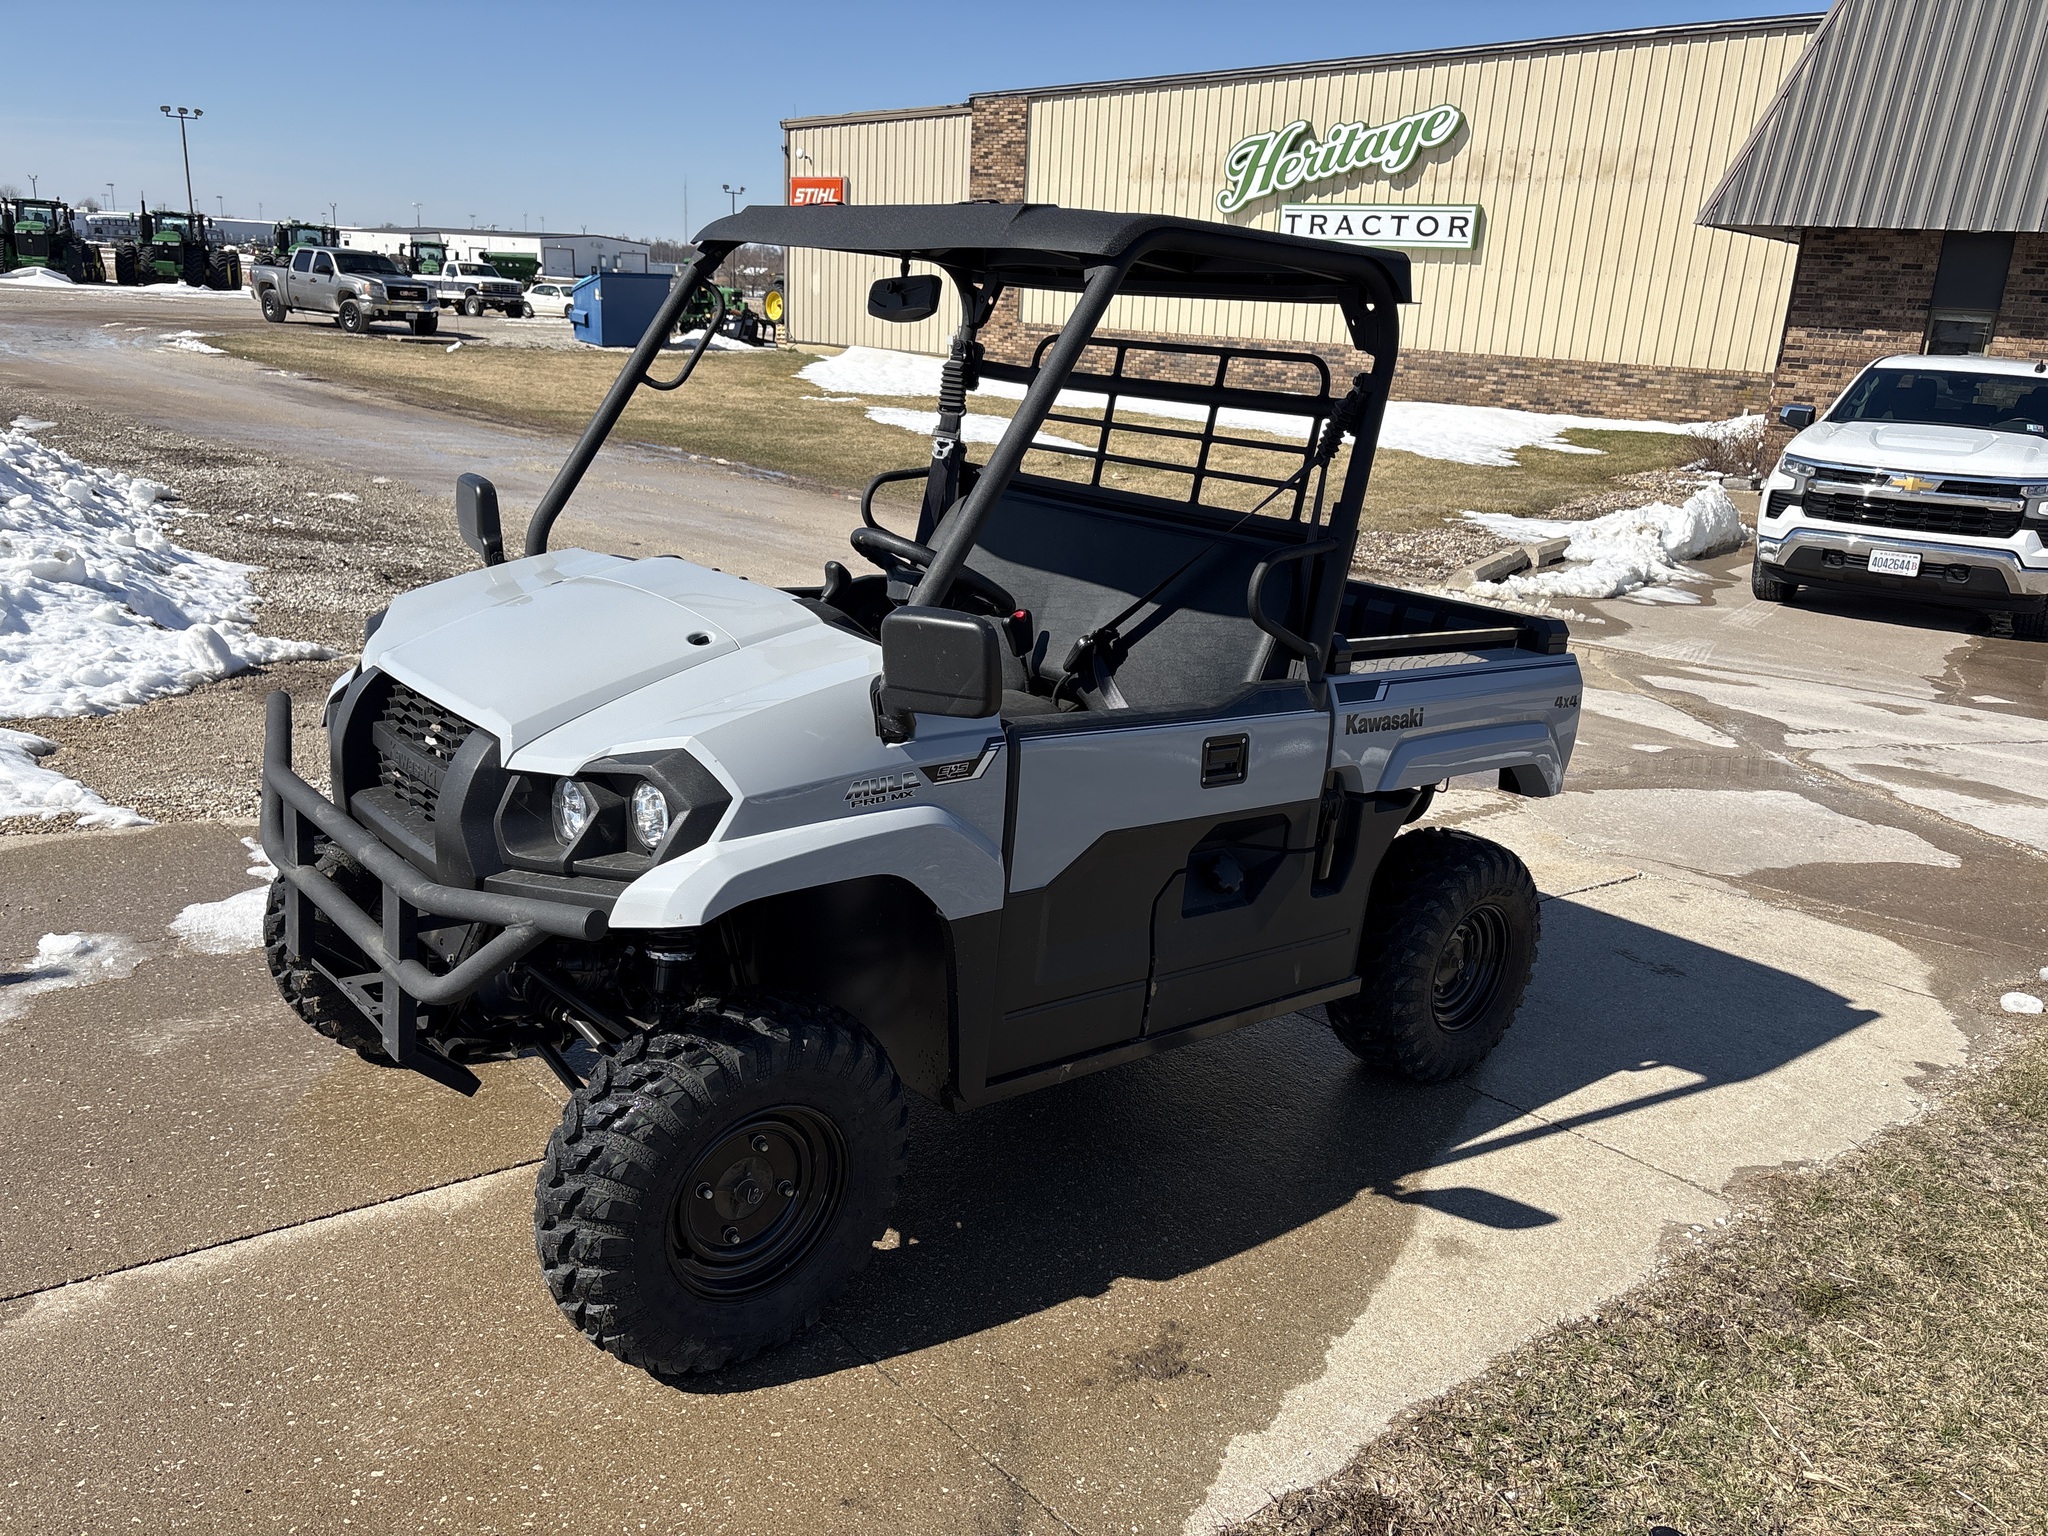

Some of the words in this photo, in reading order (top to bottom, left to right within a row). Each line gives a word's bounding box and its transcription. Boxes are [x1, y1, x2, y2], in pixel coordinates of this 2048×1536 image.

[1217, 104, 1463, 213] Heritage
[794, 187, 838, 204] STIHL
[1285, 213, 1469, 238] TRACTOR
[1872, 556, 1911, 571] 4042644
[1554, 696, 1578, 709] 4x4
[1345, 707, 1424, 735] Kawasaki
[389, 739, 437, 789] Kawasaki
[843, 771, 922, 801] MULE
